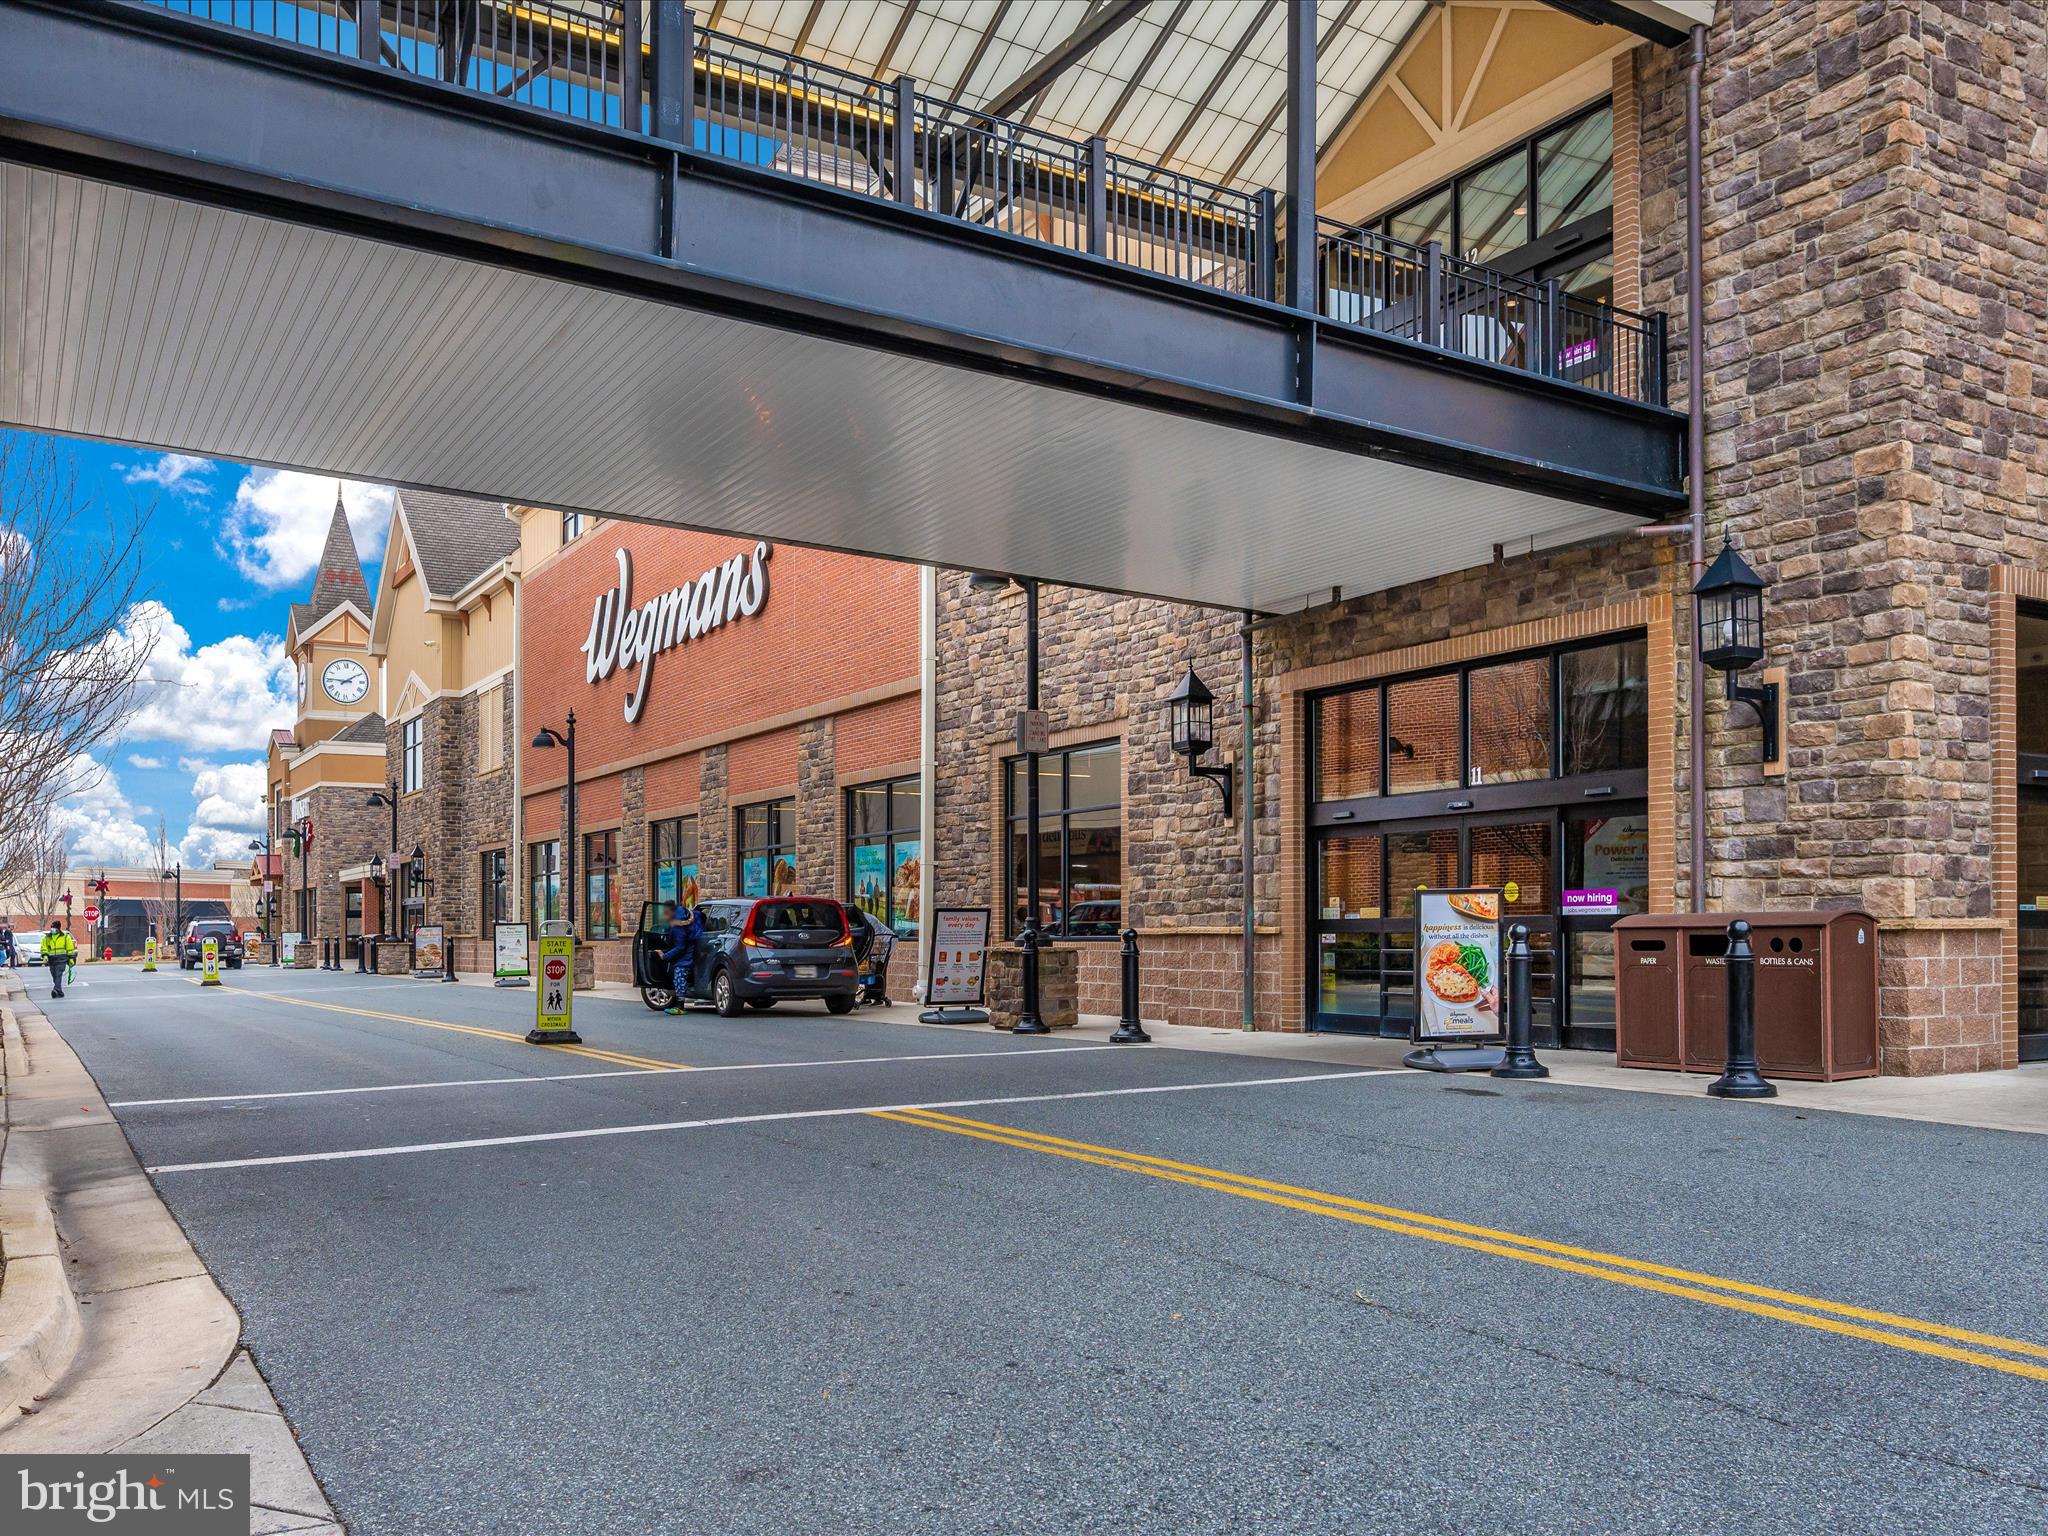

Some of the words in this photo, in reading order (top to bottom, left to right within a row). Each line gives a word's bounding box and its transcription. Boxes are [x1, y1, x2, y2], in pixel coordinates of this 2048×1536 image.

[1464, 247, 1478, 269] 12
[580, 541, 767, 723] Wegmans
[1471, 767, 1482, 785] 11
[1594, 844, 1637, 856] Power
[1587, 892, 1612, 904] hiring
[943, 915, 960, 923] family
[964, 921, 975, 929] day
[1423, 923, 1462, 933] happiness
[1640, 957, 1657, 965] PAPER
[1760, 957, 1785, 965] BOTTLES
[1787, 957, 1792, 965] &
[1794, 957, 1813, 966] CANS
[546, 965, 566, 975] STOP
[1452, 1016, 1474, 1024] meals
